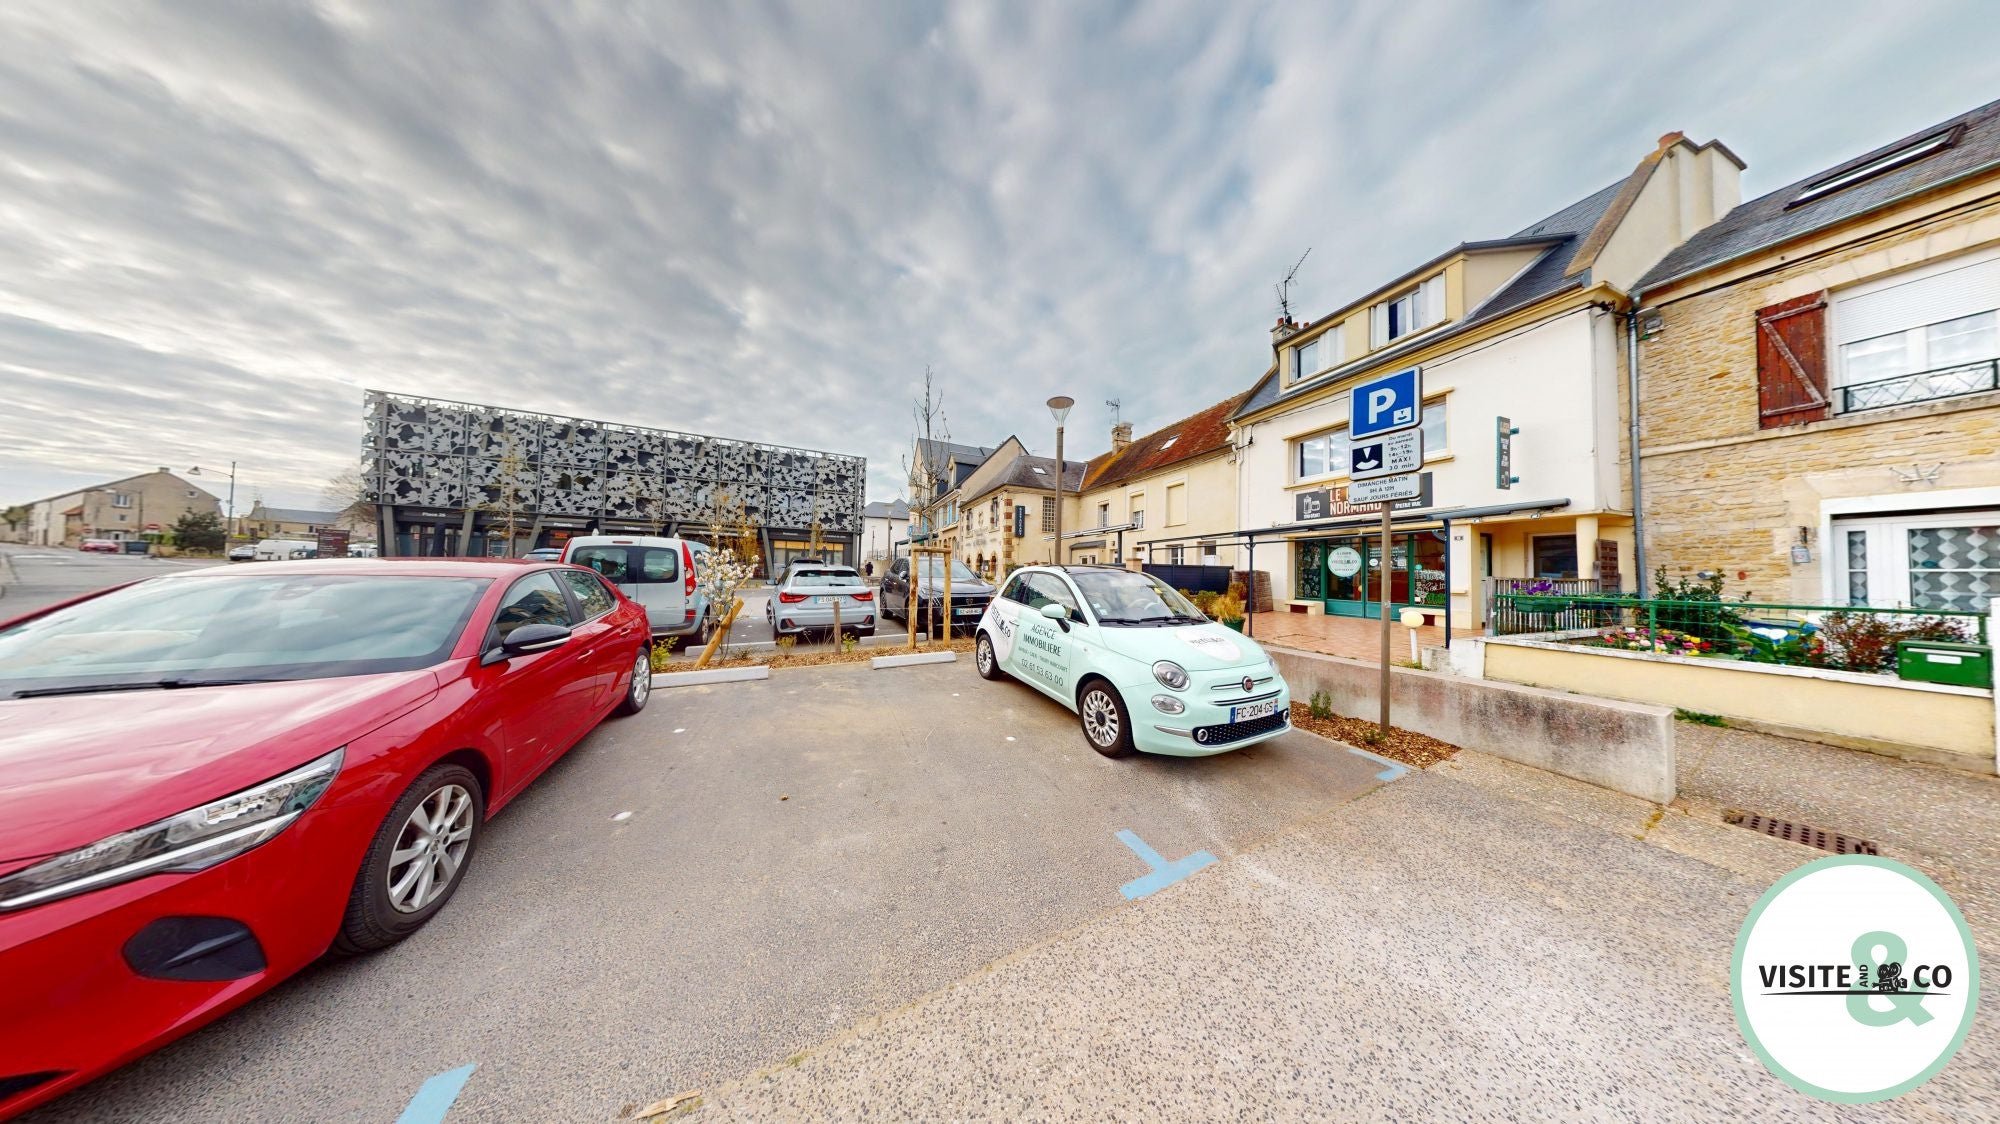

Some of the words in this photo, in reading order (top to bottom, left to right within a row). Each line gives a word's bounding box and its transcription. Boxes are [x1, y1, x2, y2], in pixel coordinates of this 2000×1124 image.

[1368, 387, 1397, 425] P
[1391, 456, 1411, 464] MAXI
[1357, 479, 1387, 488] DIMANCHE
[1329, 489, 1341, 502] LE
[1032, 624, 1057, 640] AGENCE
